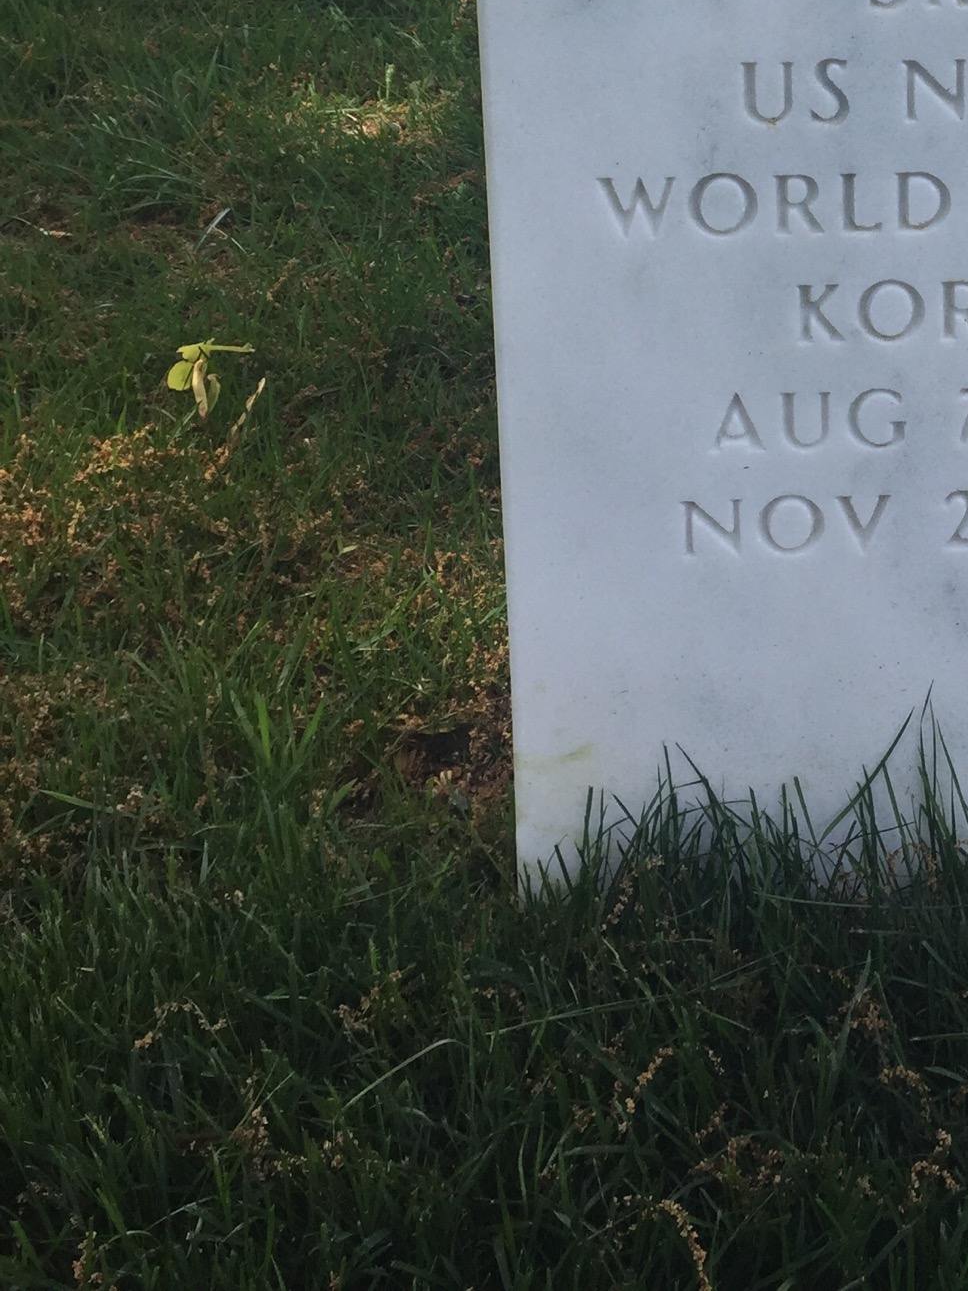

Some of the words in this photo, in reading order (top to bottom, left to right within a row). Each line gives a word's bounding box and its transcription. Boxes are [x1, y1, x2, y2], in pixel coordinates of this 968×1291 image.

[740, 57, 850, 126] US
[596, 171, 953, 237] WORLD
[711, 388, 908, 450] AUG
[682, 493, 892, 555] NOV
